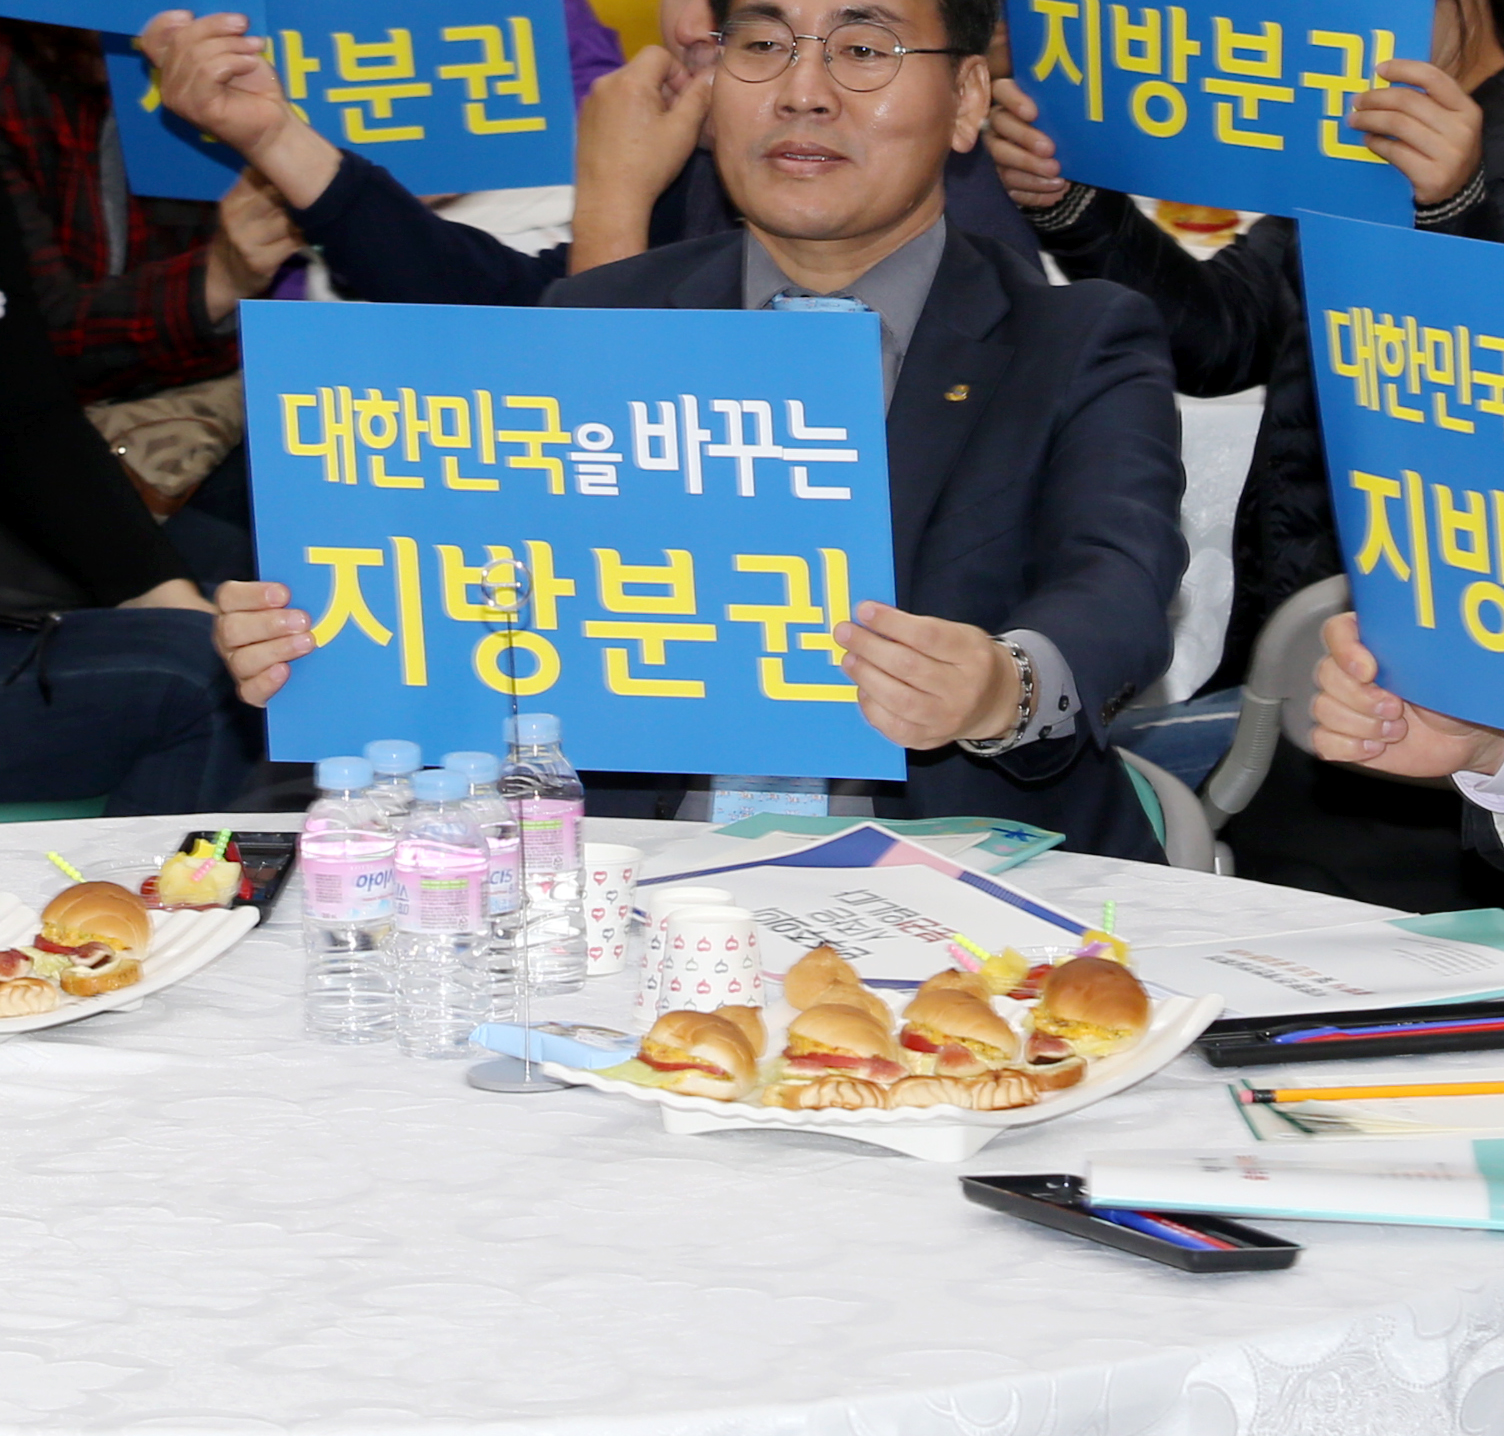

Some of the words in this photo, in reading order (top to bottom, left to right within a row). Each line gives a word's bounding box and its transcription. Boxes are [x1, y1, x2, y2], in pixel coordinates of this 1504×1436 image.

[278, 386, 623, 497] 대한민국을
[629, 394, 859, 501] 바꾸는
[301, 536, 861, 704] 지방분권
[356, 868, 394, 889] 아이
[488, 868, 513, 884] CIS
